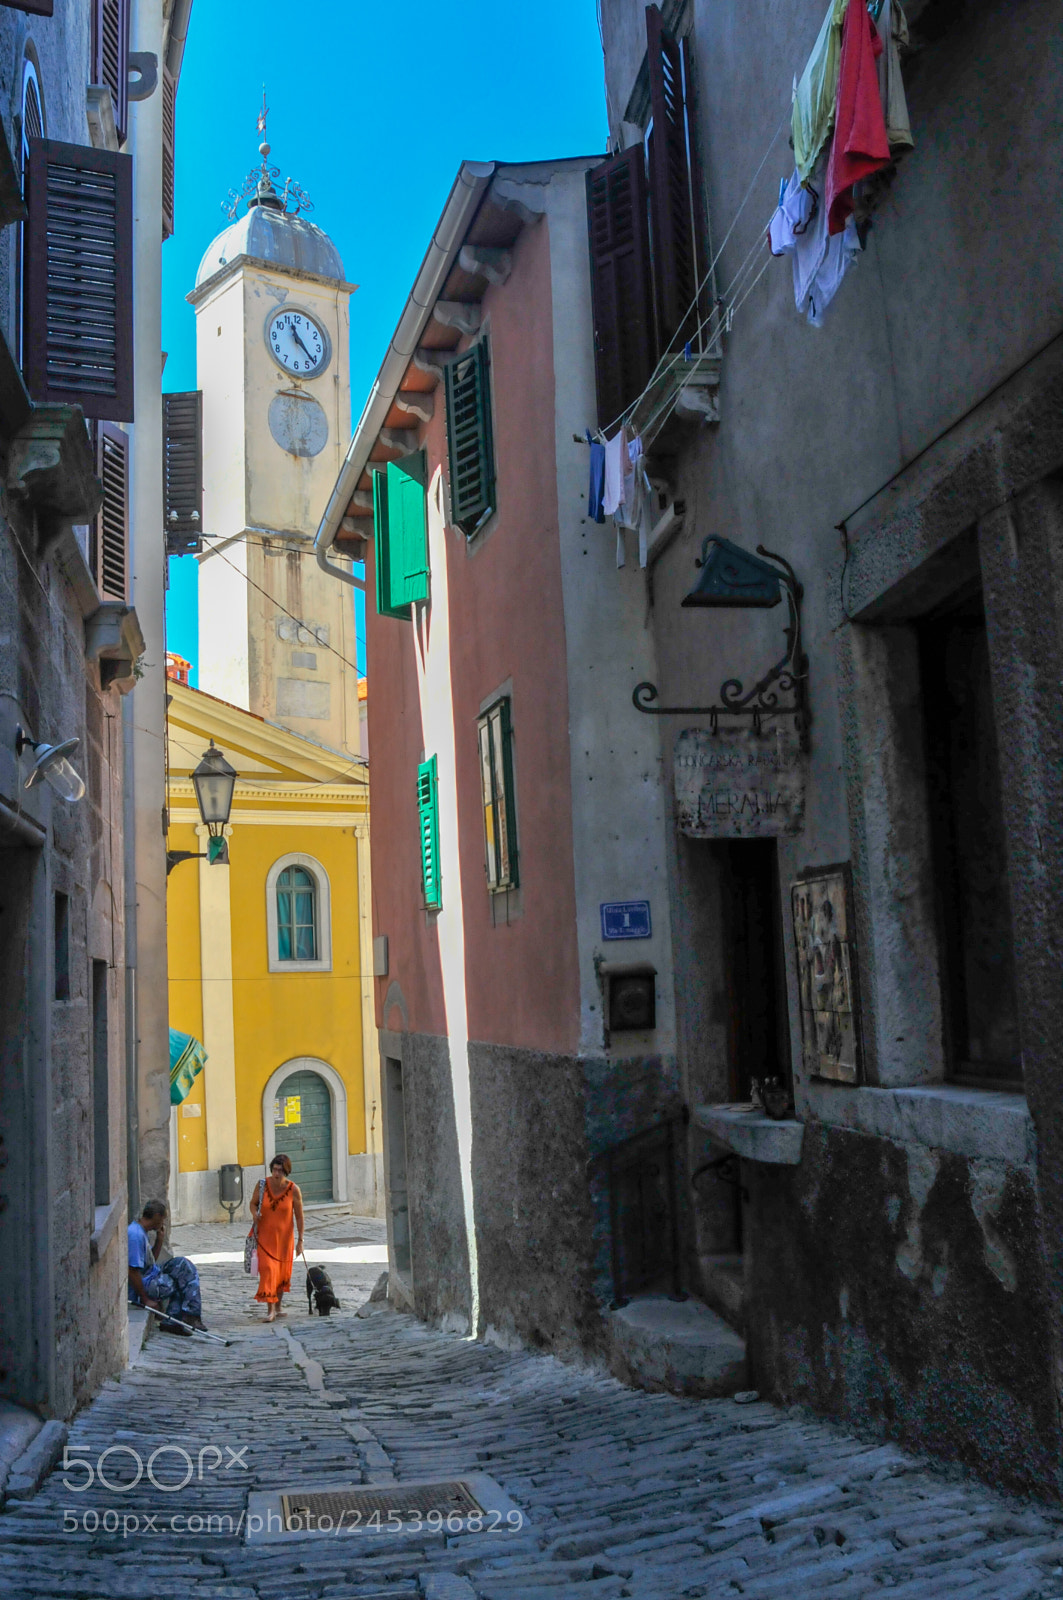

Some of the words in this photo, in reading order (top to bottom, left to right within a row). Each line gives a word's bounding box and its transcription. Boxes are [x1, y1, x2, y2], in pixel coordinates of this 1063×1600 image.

[284, 315, 290, 325] 11
[293, 314, 301, 324] 12
[276, 321, 284, 330] 10
[306, 322, 310, 330] 1
[272, 331, 277, 340] 9
[313, 331, 318, 340] 2
[275, 344, 280, 353] 8
[316, 344, 321, 353] 3
[283, 354, 289, 363] 7
[312, 355, 318, 364] 4
[293, 361, 299, 370] 6
[304, 361, 310, 369] 5
[623, 913, 630, 928] 1
